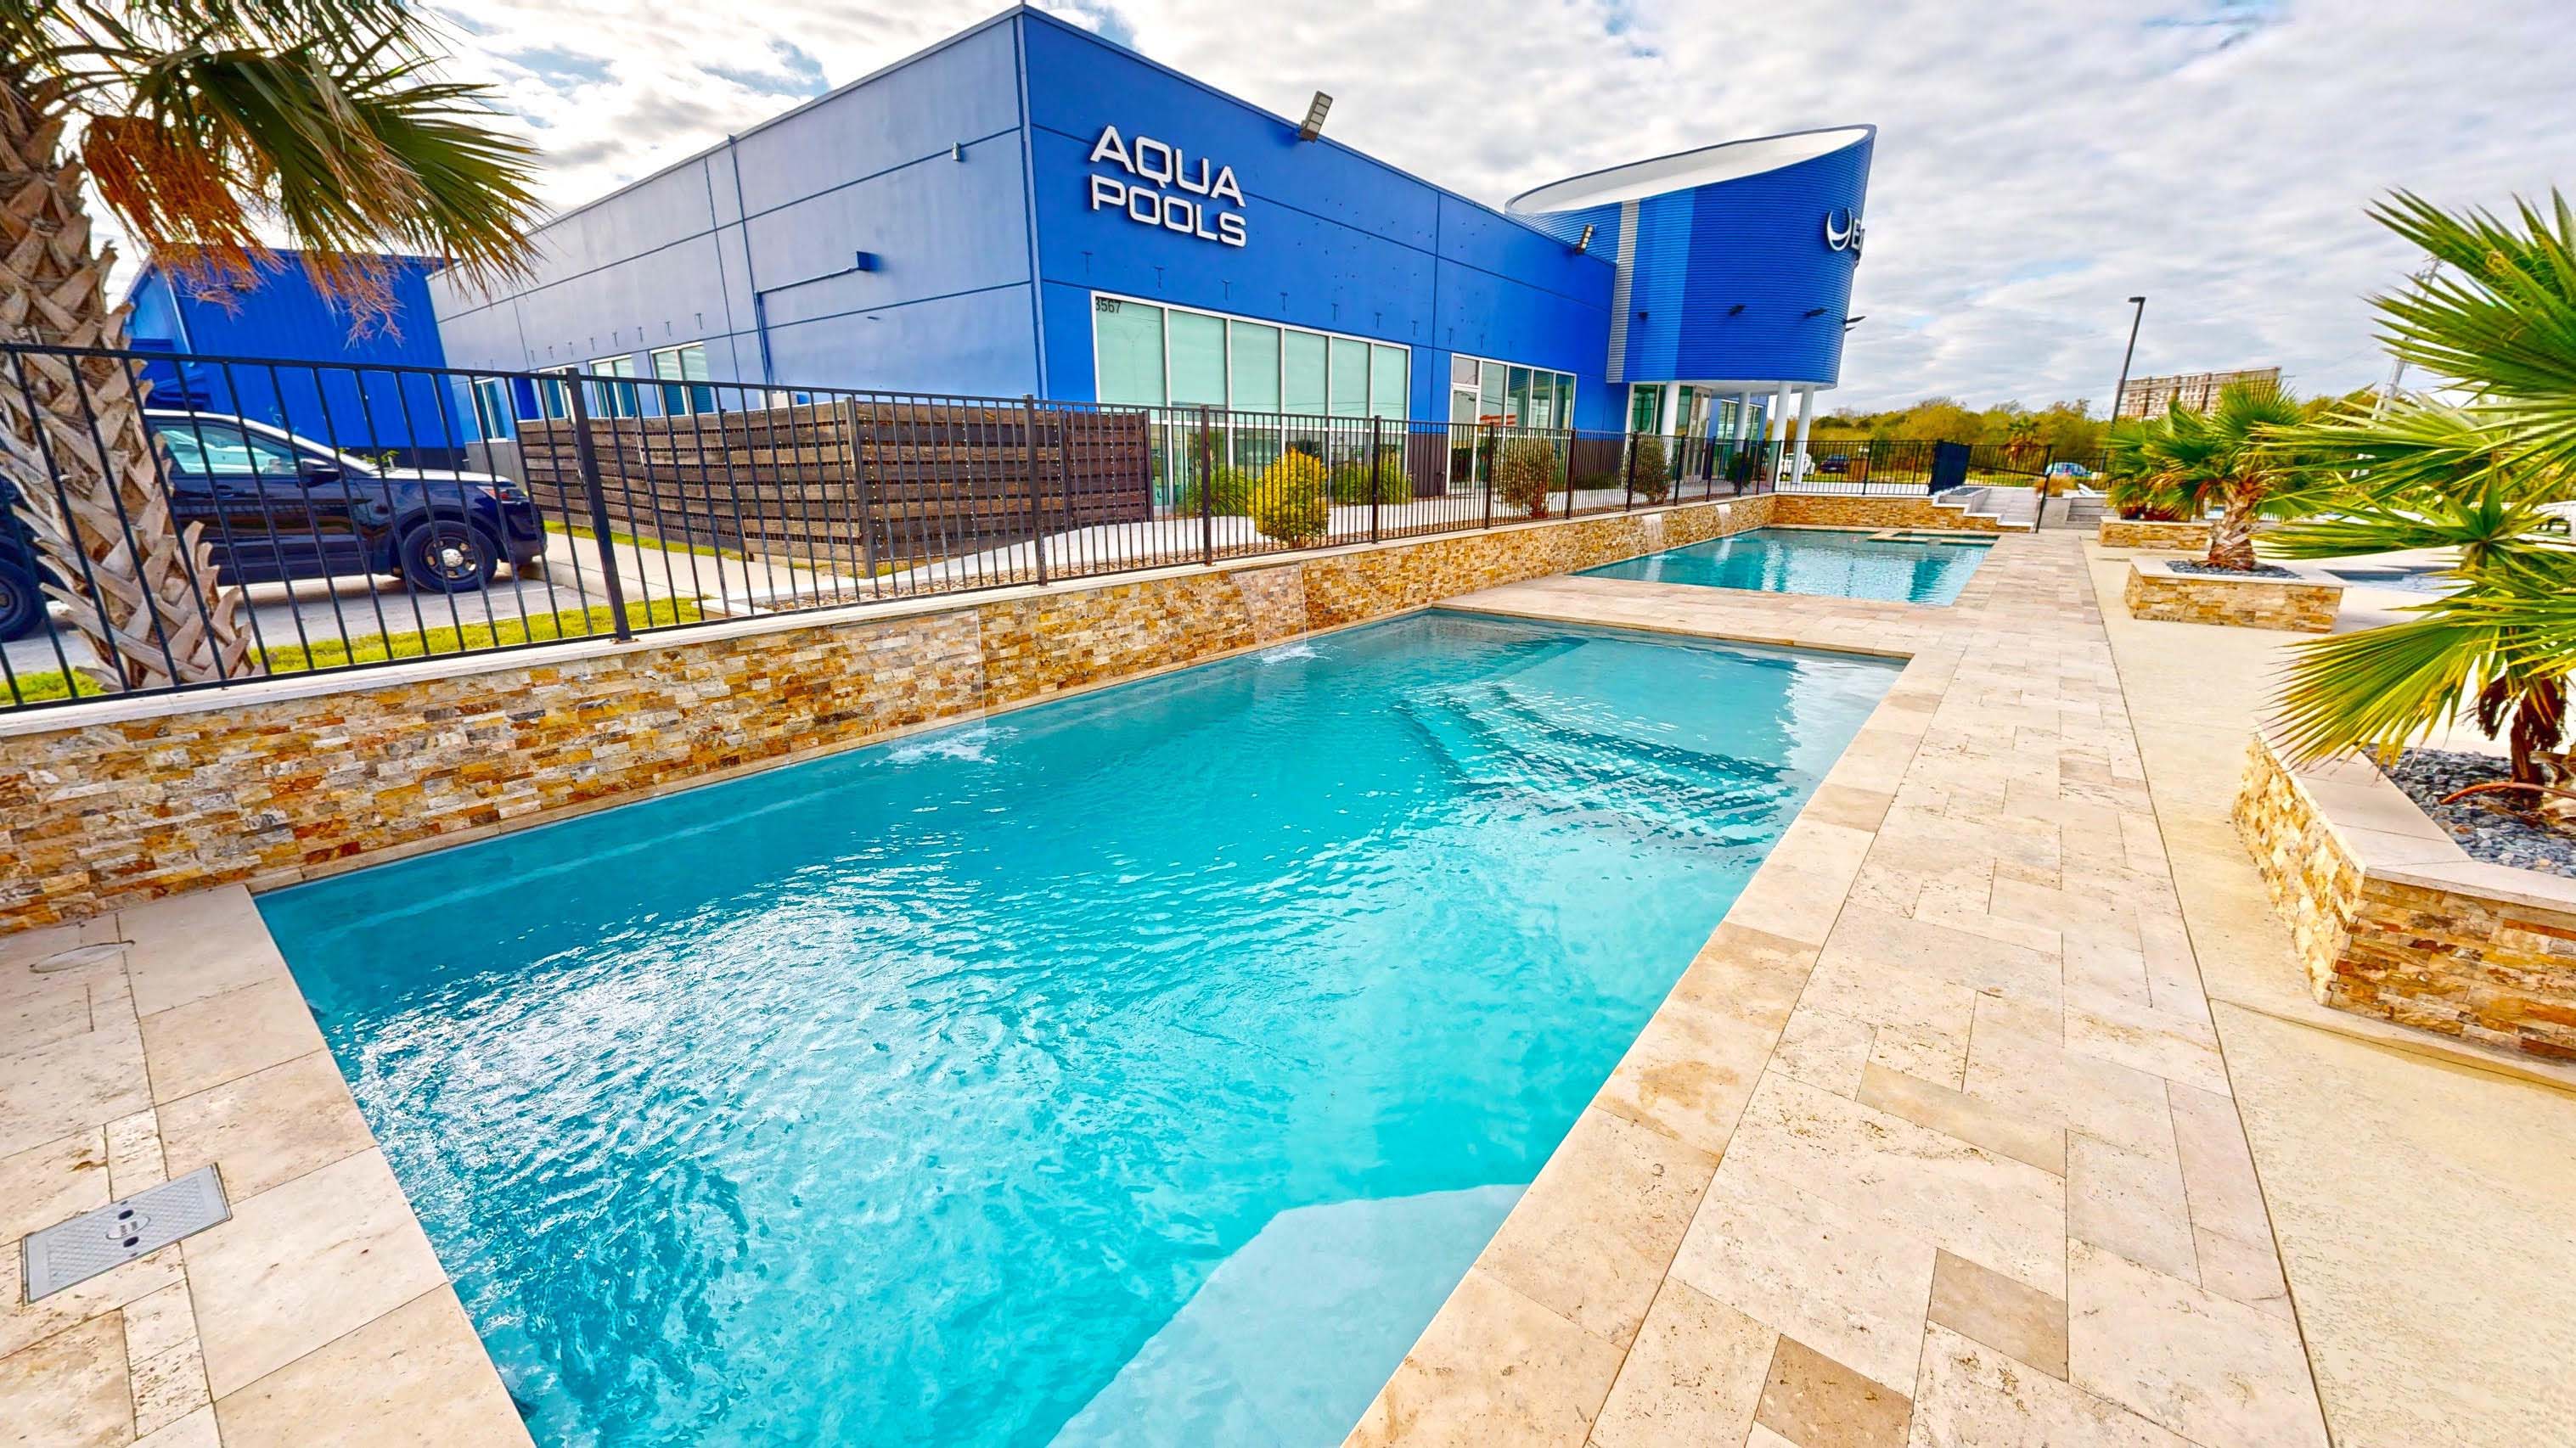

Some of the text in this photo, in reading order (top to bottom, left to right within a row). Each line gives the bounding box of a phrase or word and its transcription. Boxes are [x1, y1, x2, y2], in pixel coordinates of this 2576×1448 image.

[1089, 124, 1246, 208] AQUA
[1091, 173, 1247, 248] POOLS
[1095, 297, 1122, 314] 3567
